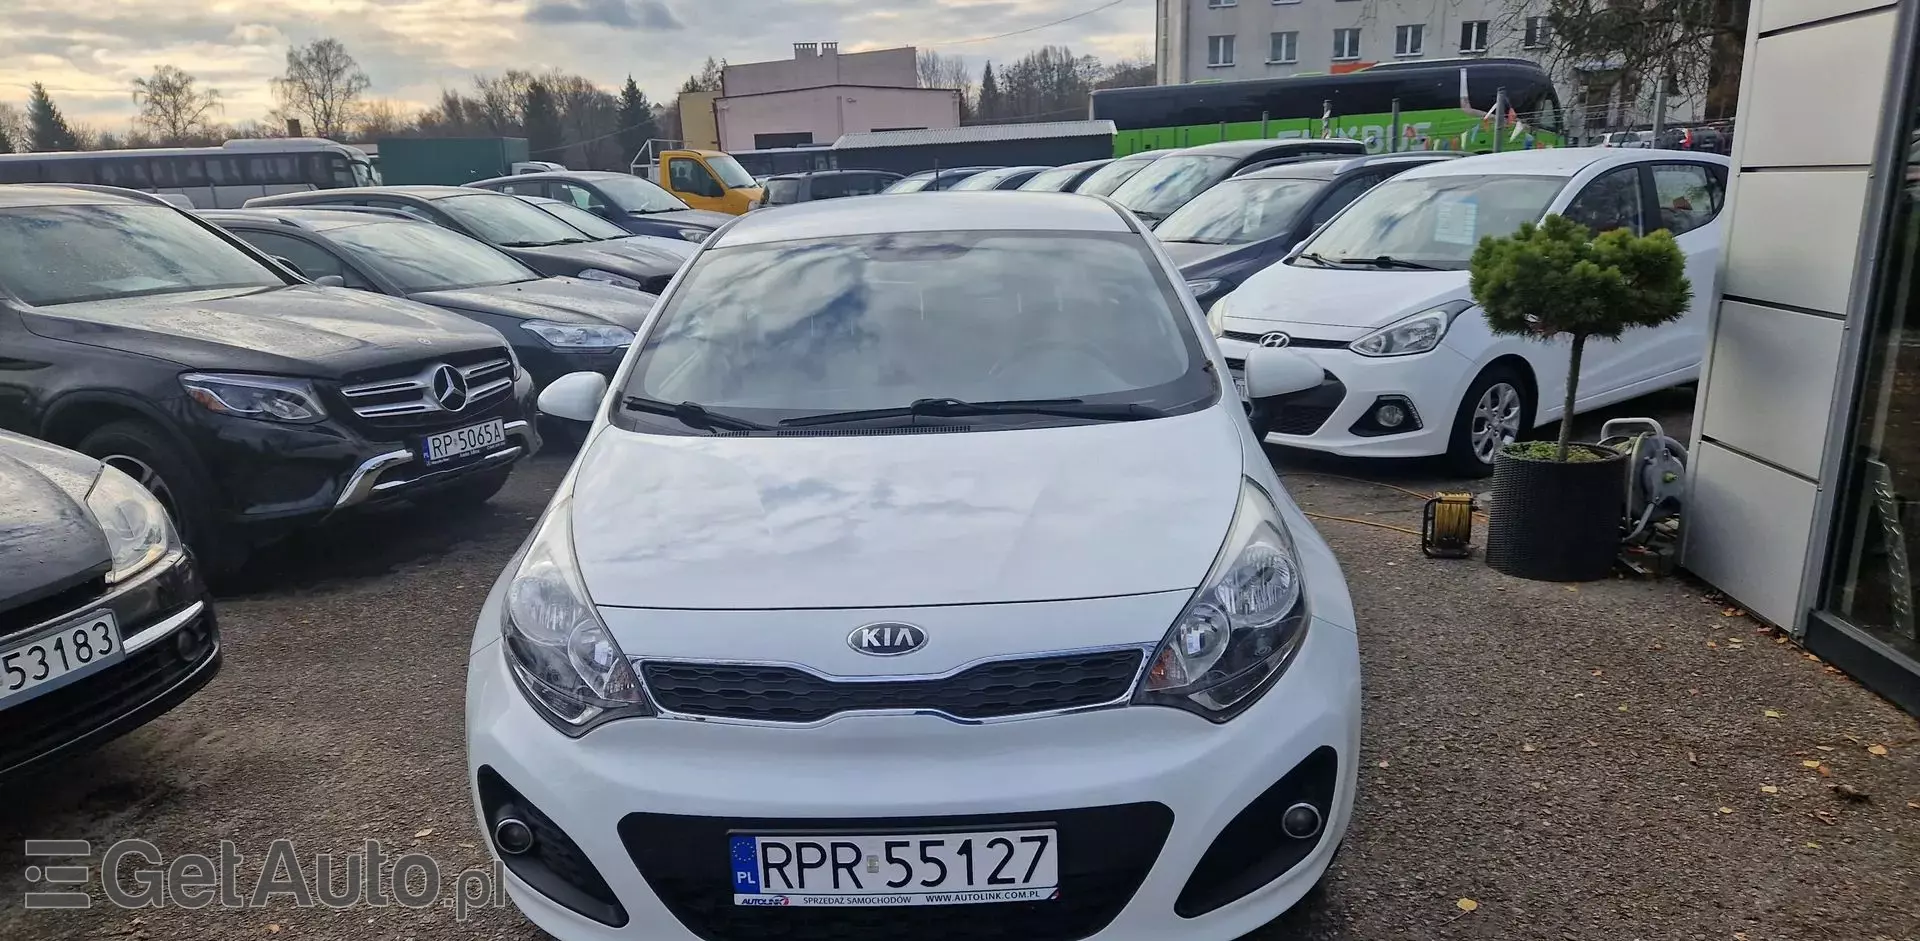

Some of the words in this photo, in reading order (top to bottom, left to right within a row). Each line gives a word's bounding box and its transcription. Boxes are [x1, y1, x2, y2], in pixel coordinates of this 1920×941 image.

[432, 434, 453, 458] RP
[458, 422, 502, 451] 5065A
[862, 627, 915, 648] KIA
[2, 621, 113, 690] 53183
[761, 842, 863, 889] RPR
[885, 835, 1049, 888] 55127
[737, 871, 756, 884] PL
[926, 890, 1040, 903] WWW.AUTOLINK.COM.PL
